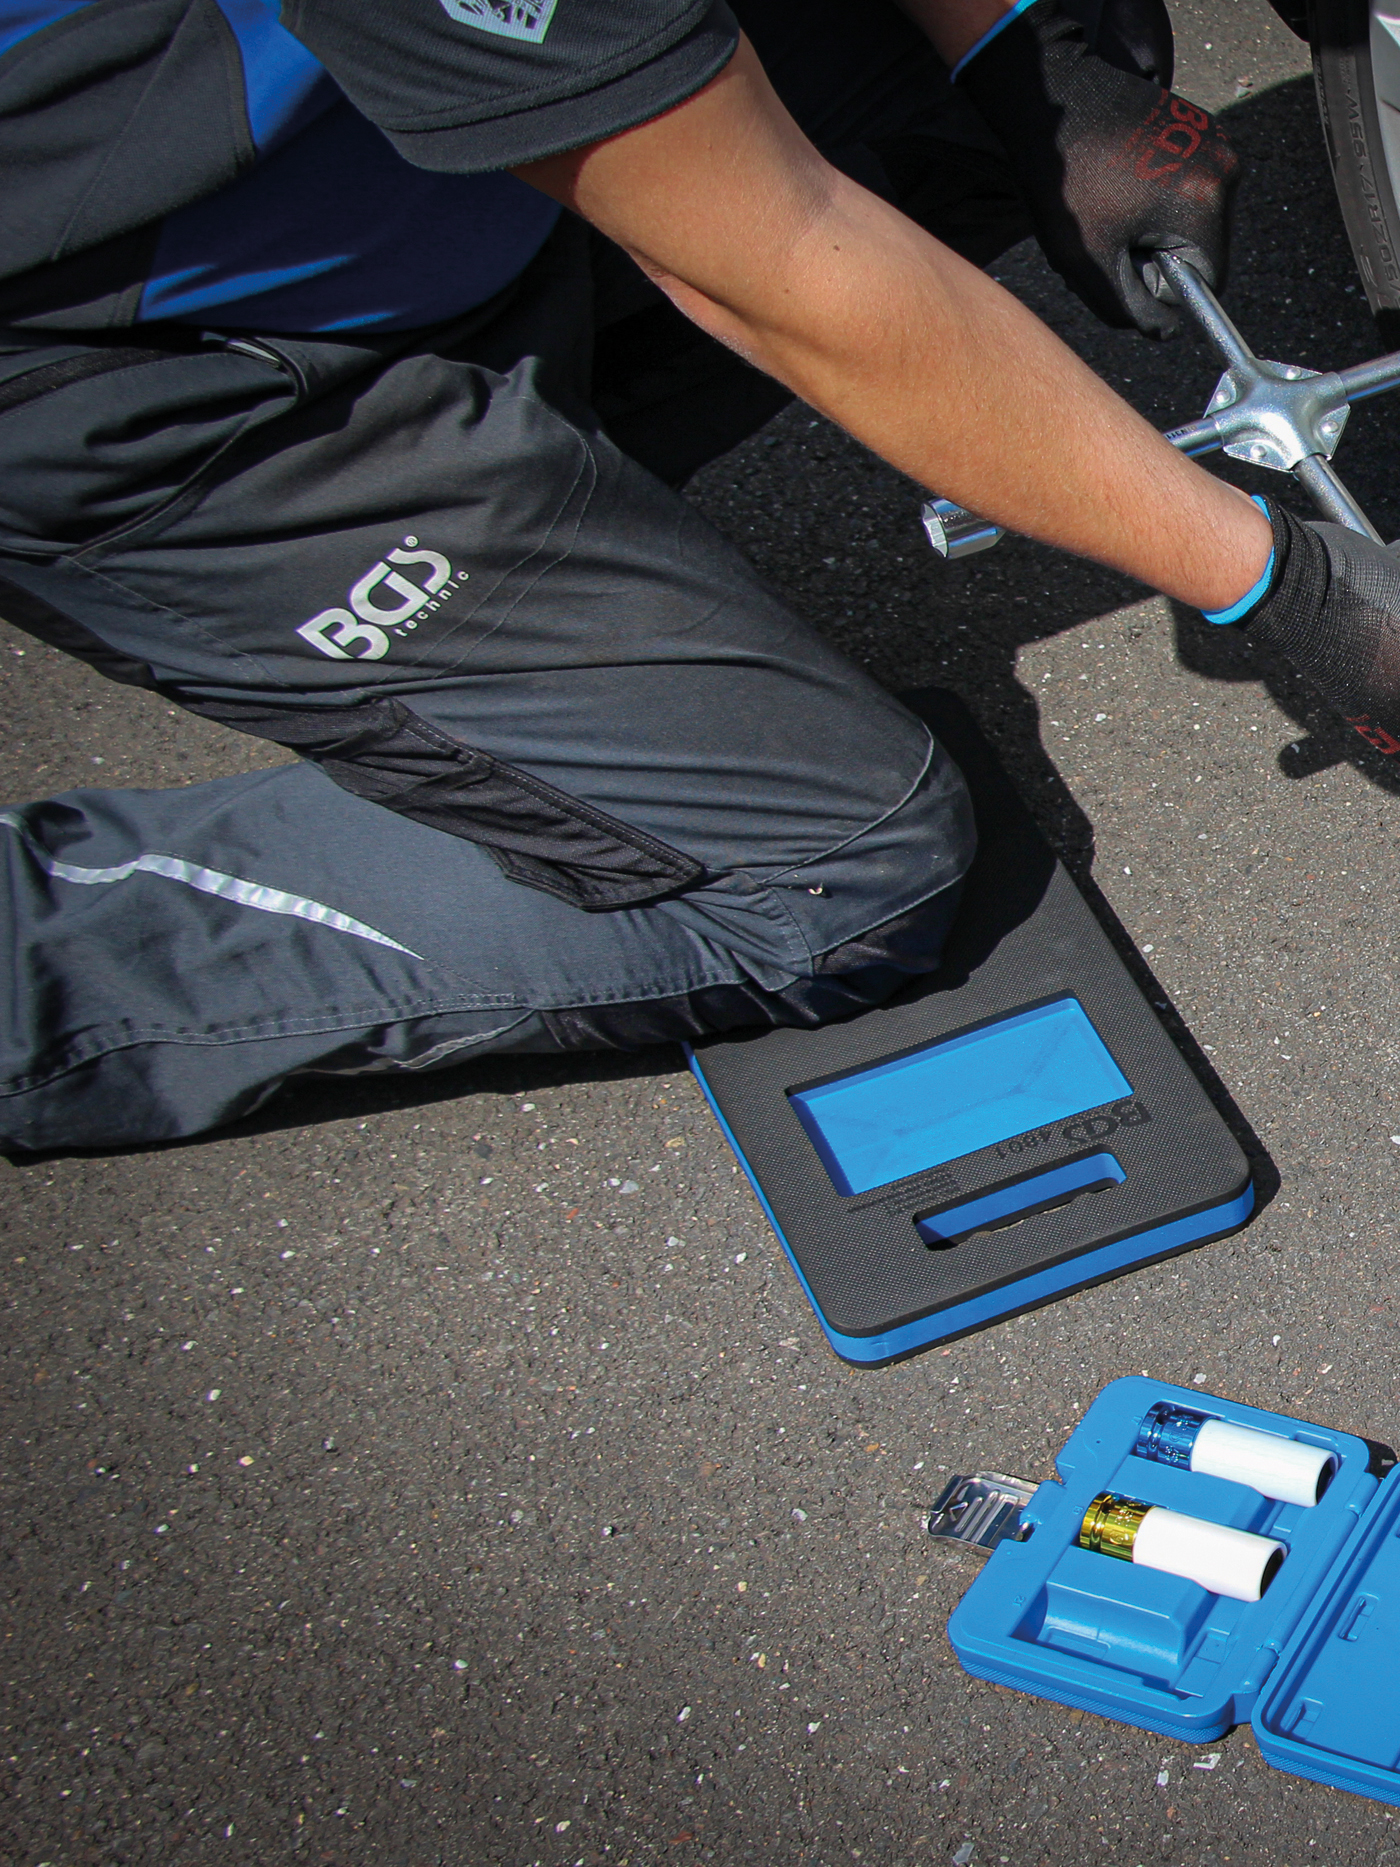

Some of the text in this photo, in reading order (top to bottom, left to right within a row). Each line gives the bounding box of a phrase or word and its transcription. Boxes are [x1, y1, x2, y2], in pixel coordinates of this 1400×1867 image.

[1345, 92, 1367, 158] 95W
[295, 546, 453, 661] BGS
[394, 570, 470, 637] technic
[1062, 1099, 1152, 1144] BGS
